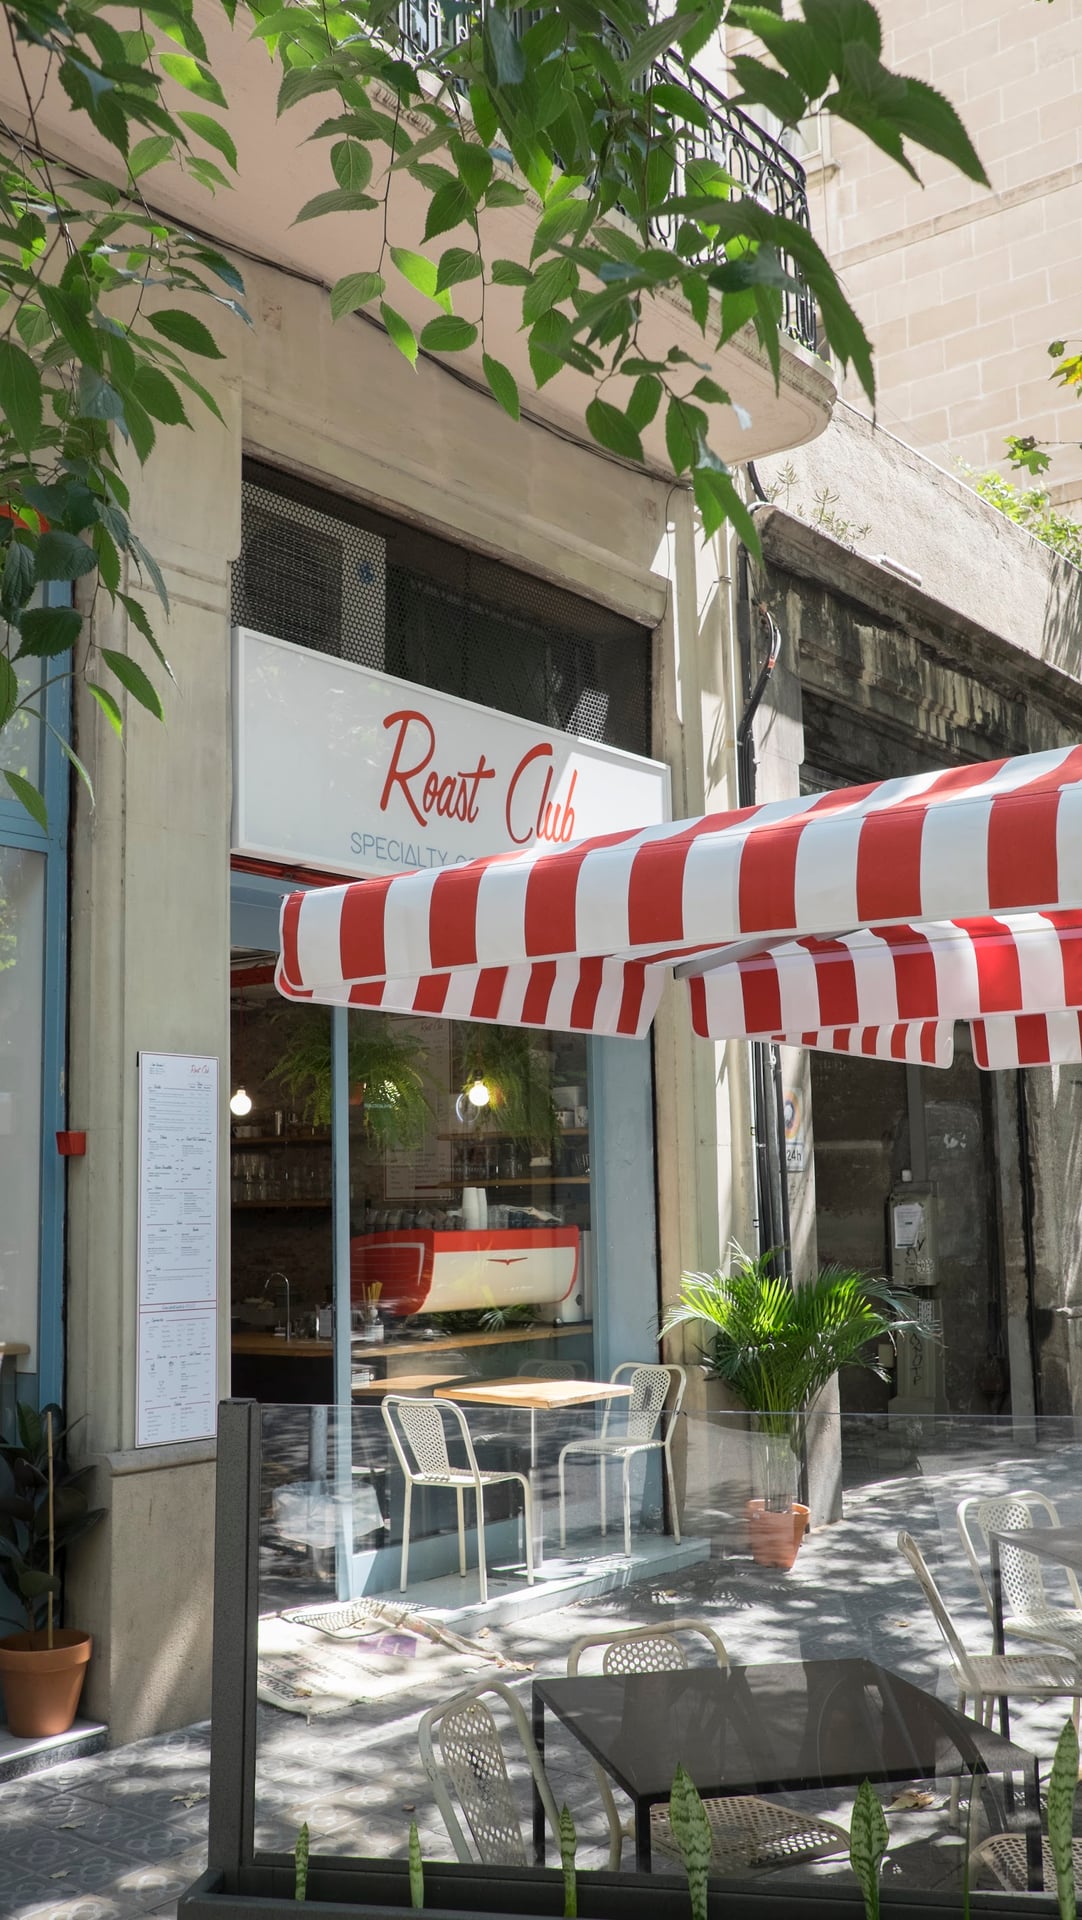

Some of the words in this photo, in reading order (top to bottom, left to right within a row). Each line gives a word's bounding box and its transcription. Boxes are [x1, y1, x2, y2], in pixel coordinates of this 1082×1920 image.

[380, 709, 496, 827] Roast
[506, 743, 578, 844] Club
[350, 831, 448, 868] SPECIALTY
[786, 1149, 802, 1161] 24h
